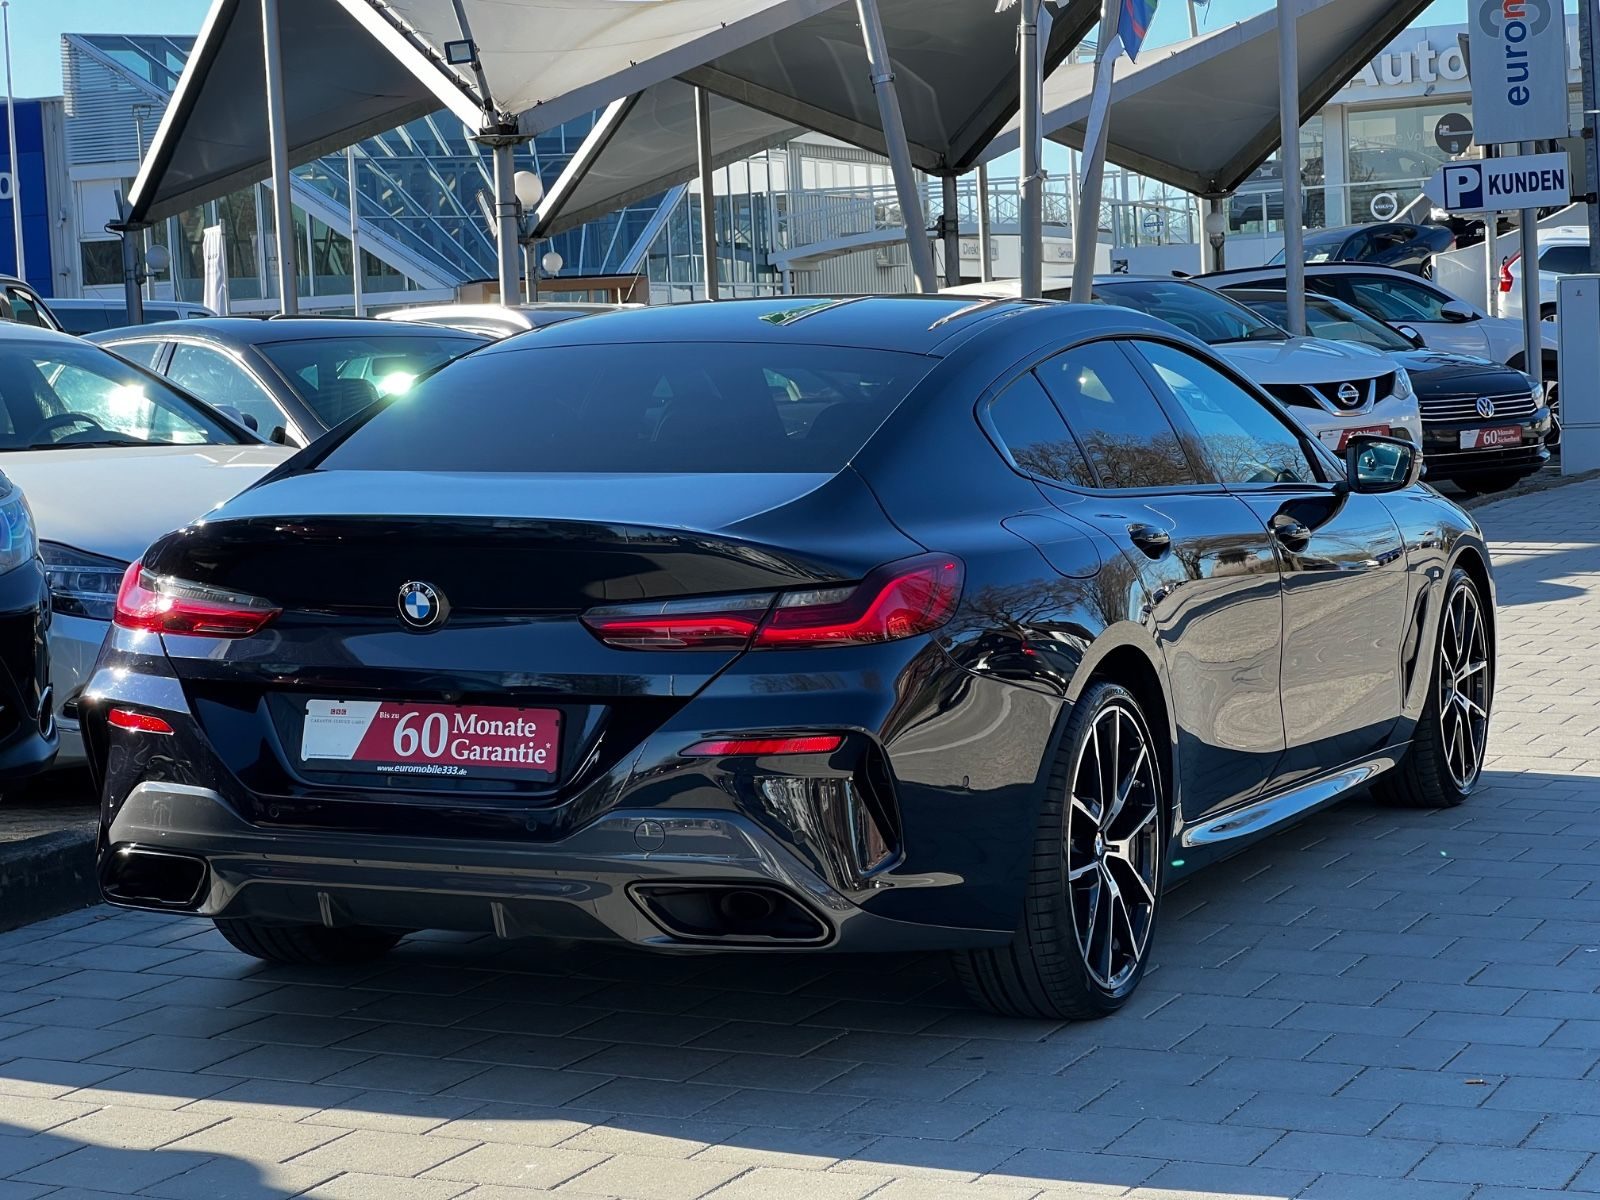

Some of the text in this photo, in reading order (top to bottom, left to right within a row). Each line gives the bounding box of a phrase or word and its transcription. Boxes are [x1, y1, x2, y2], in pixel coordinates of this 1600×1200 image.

[1445, 167, 1565, 209] P KUNDEN
[1483, 430, 1497, 445] 60
[401, 583, 434, 599] BMW
[379, 711, 390, 719] Bis
[452, 713, 537, 738] Monate
[393, 711, 449, 758] 60
[376, 764, 468, 776] www.euromobile333.de
